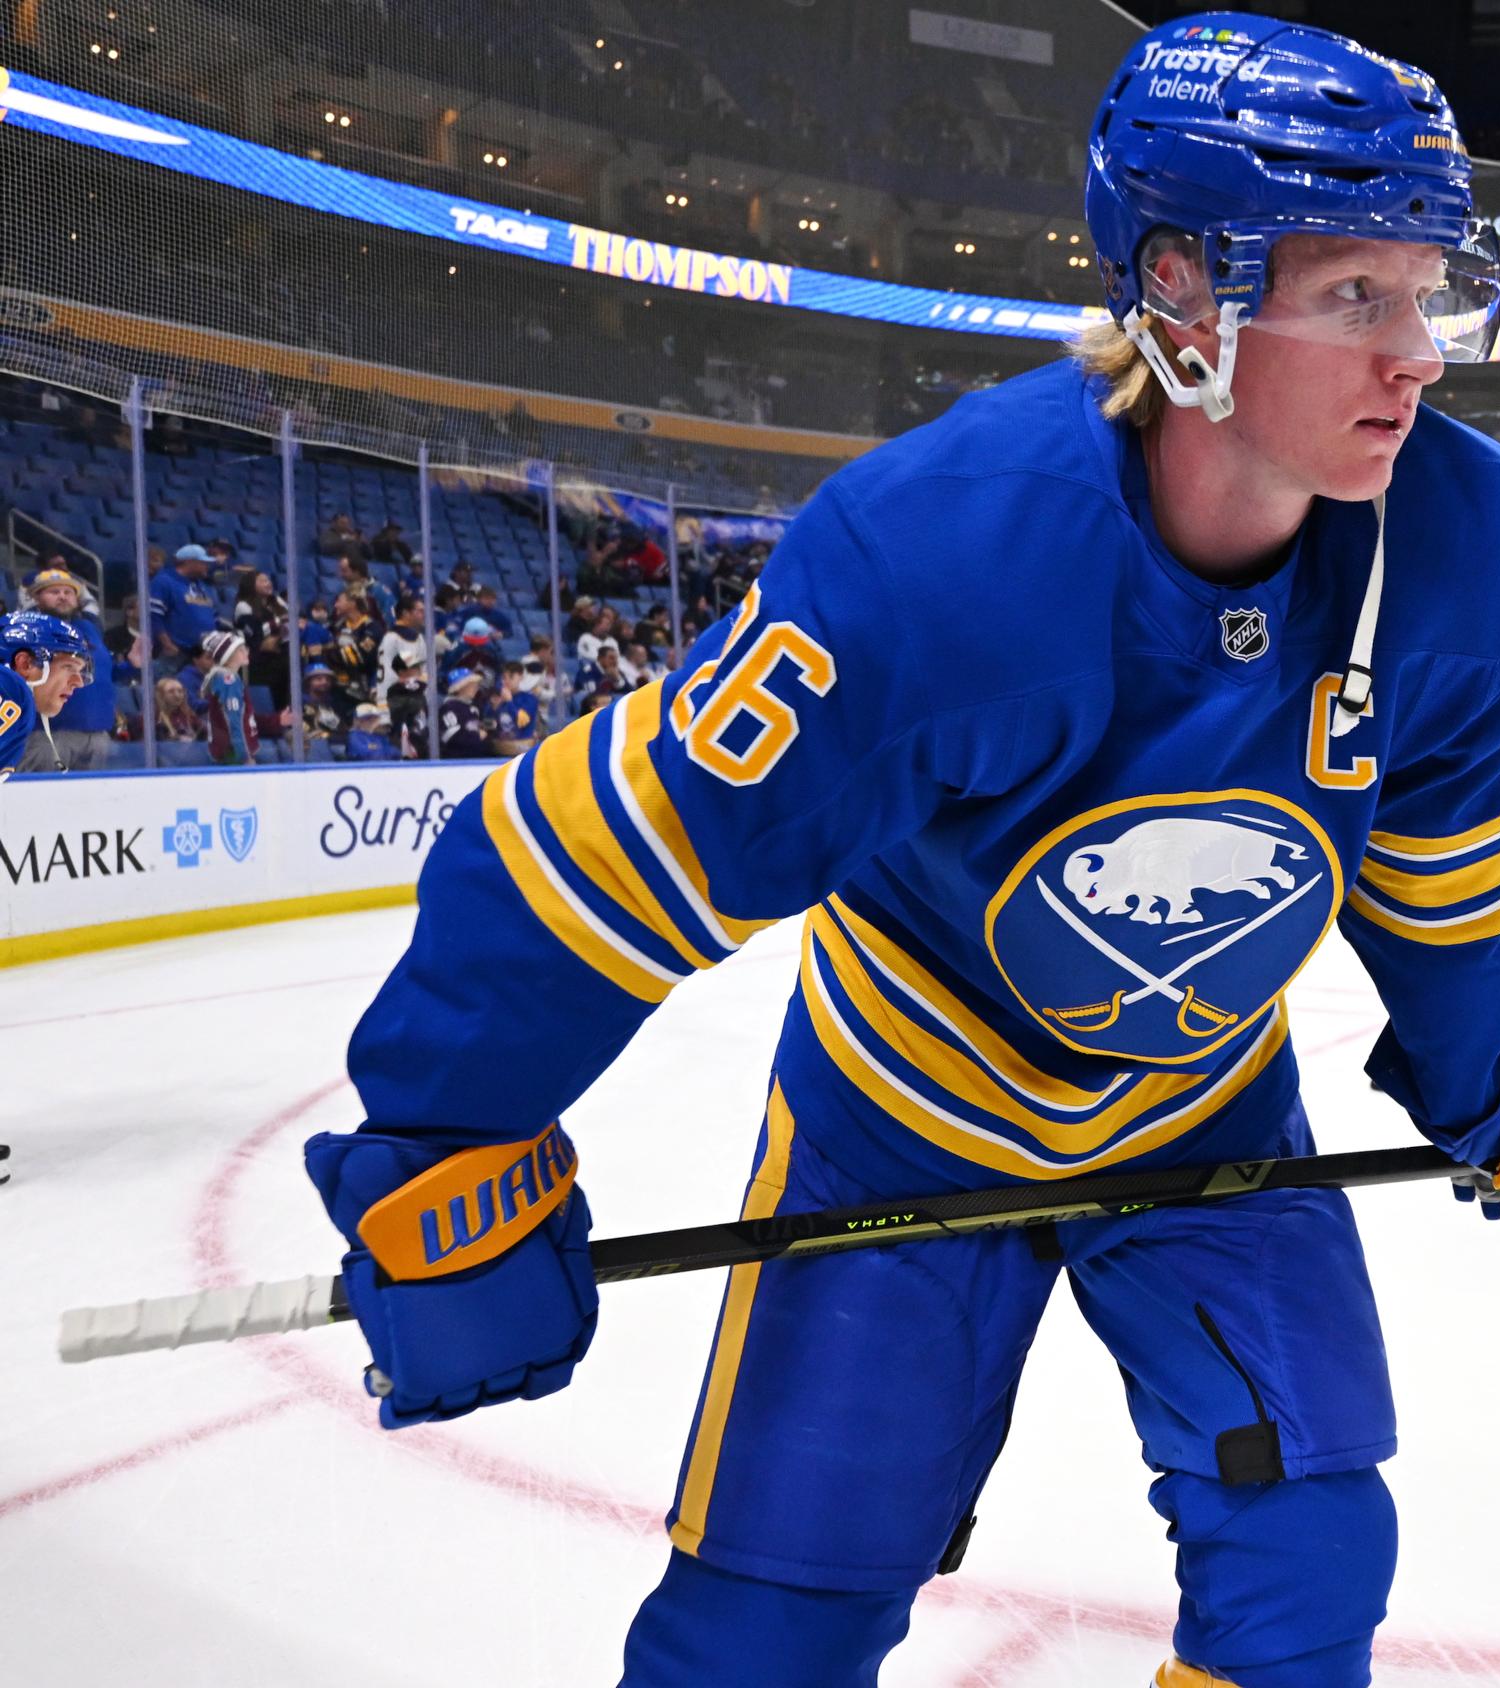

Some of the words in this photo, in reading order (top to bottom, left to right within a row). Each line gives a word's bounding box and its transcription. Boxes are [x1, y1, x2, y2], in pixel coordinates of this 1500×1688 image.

[1139, 41, 1271, 82] Trusted
[449, 207, 549, 250] TAGE
[568, 223, 794, 304] THOMPSON
[1232, 611, 1258, 649] NHL
[1305, 670, 1379, 791] C
[846, 1213, 915, 1230] ALPHA
